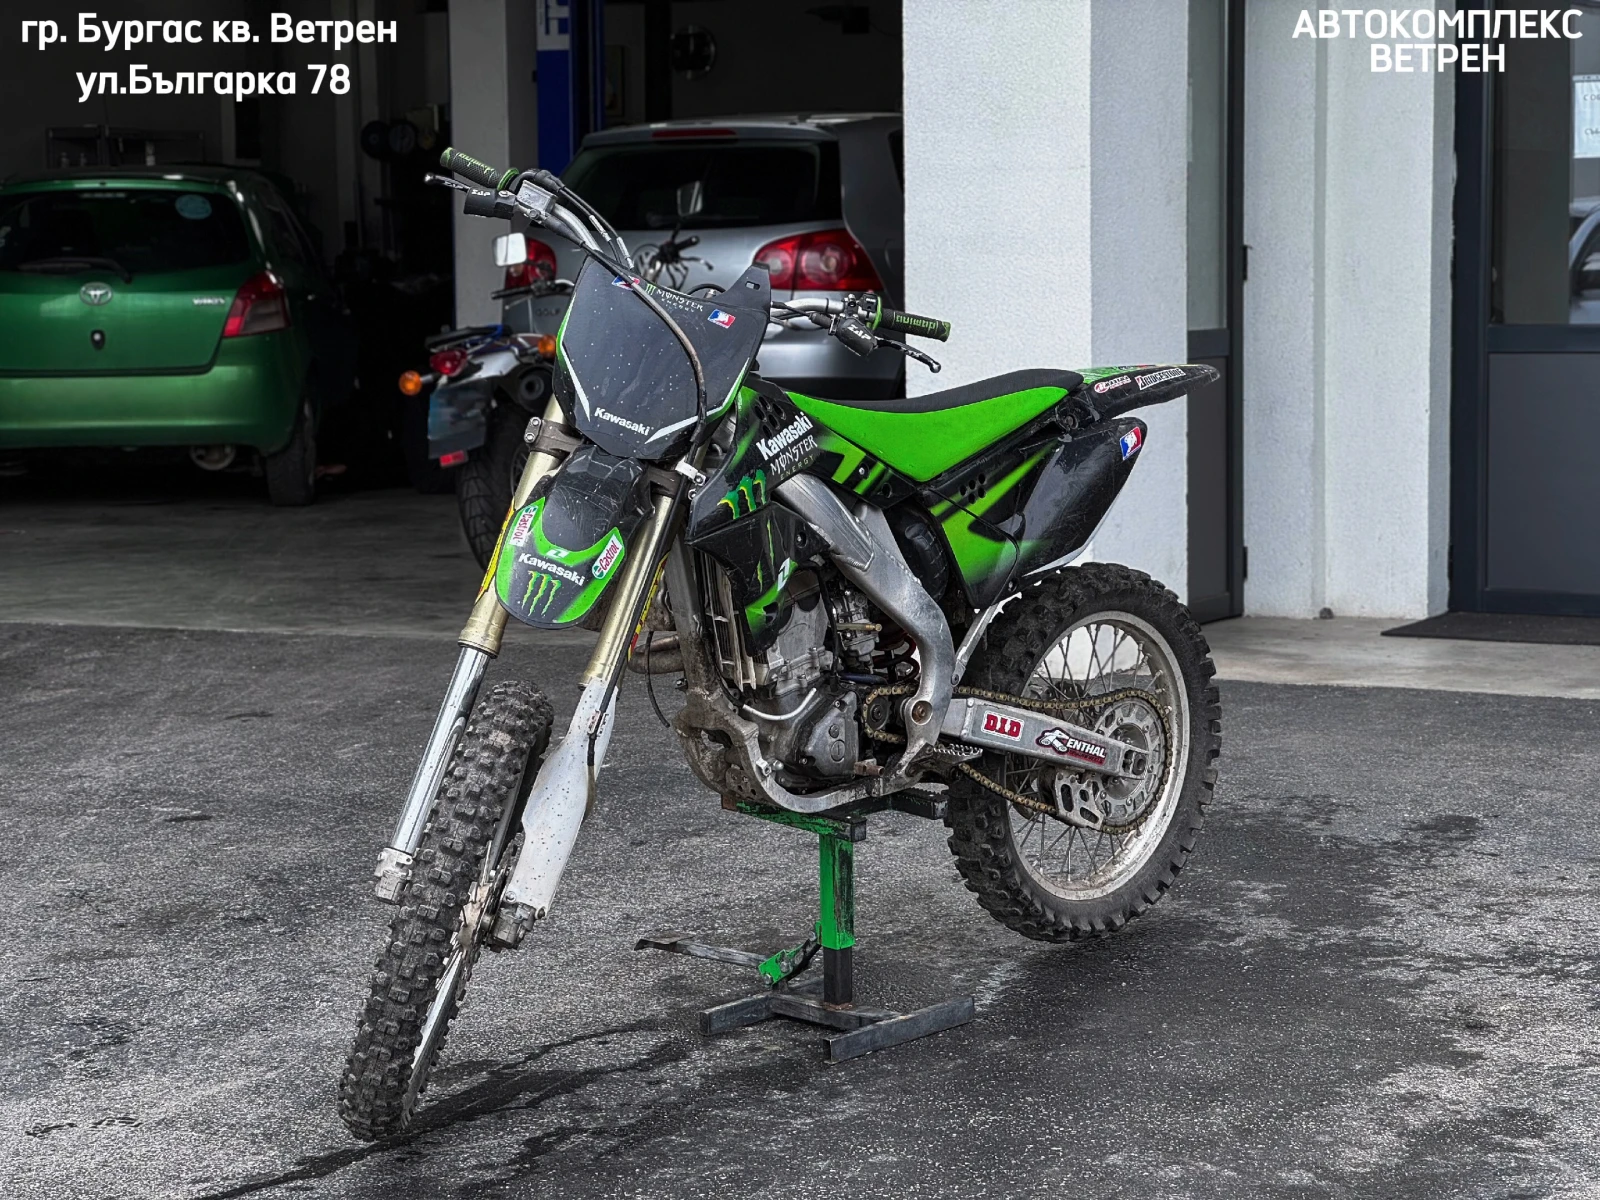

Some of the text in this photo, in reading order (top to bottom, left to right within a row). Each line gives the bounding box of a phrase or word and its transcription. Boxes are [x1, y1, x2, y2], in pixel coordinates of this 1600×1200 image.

[847, 324, 872, 341] ZAP
[594, 407, 650, 436] Kawasaki
[756, 411, 814, 461] Kawasaki
[770, 435, 818, 476] MONSTER
[780, 455, 814, 480] ENERGY
[512, 513, 534, 541] Castrol
[517, 552, 587, 587] Kawasaki
[599, 540, 620, 572] Castrol
